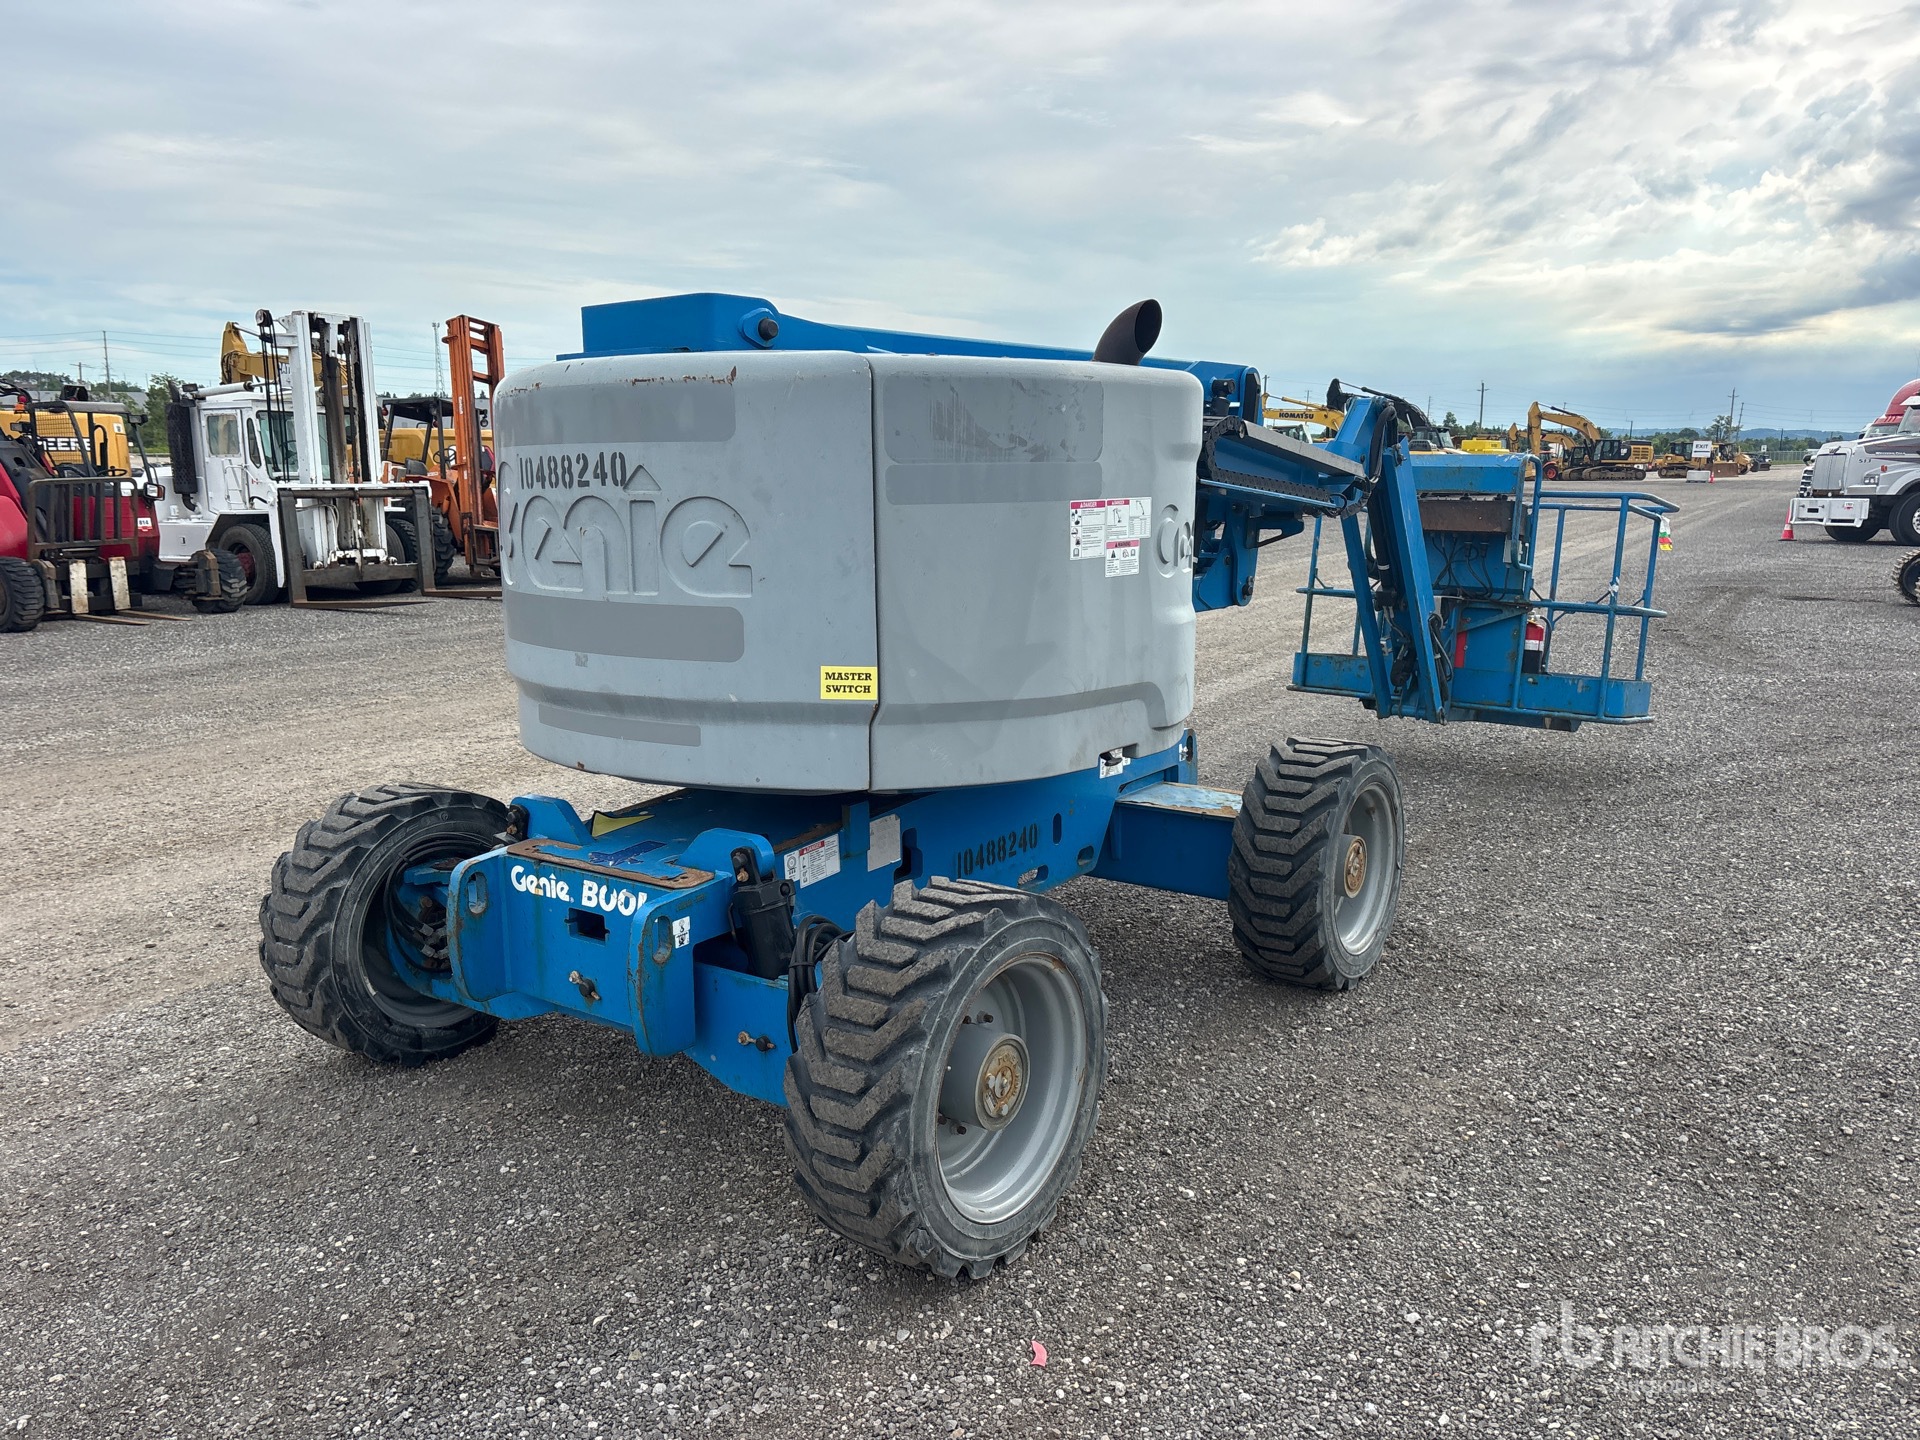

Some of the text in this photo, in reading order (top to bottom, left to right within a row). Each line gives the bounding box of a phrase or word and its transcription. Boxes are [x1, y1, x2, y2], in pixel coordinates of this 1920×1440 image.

[1279, 412, 1314, 420] KOMATSU
[37, 437, 91, 451] EERE
[520, 451, 627, 490] 10488240
[825, 671, 872, 681] MASTER
[825, 684, 871, 694] SWITCH
[957, 823, 1038, 880] 10488240
